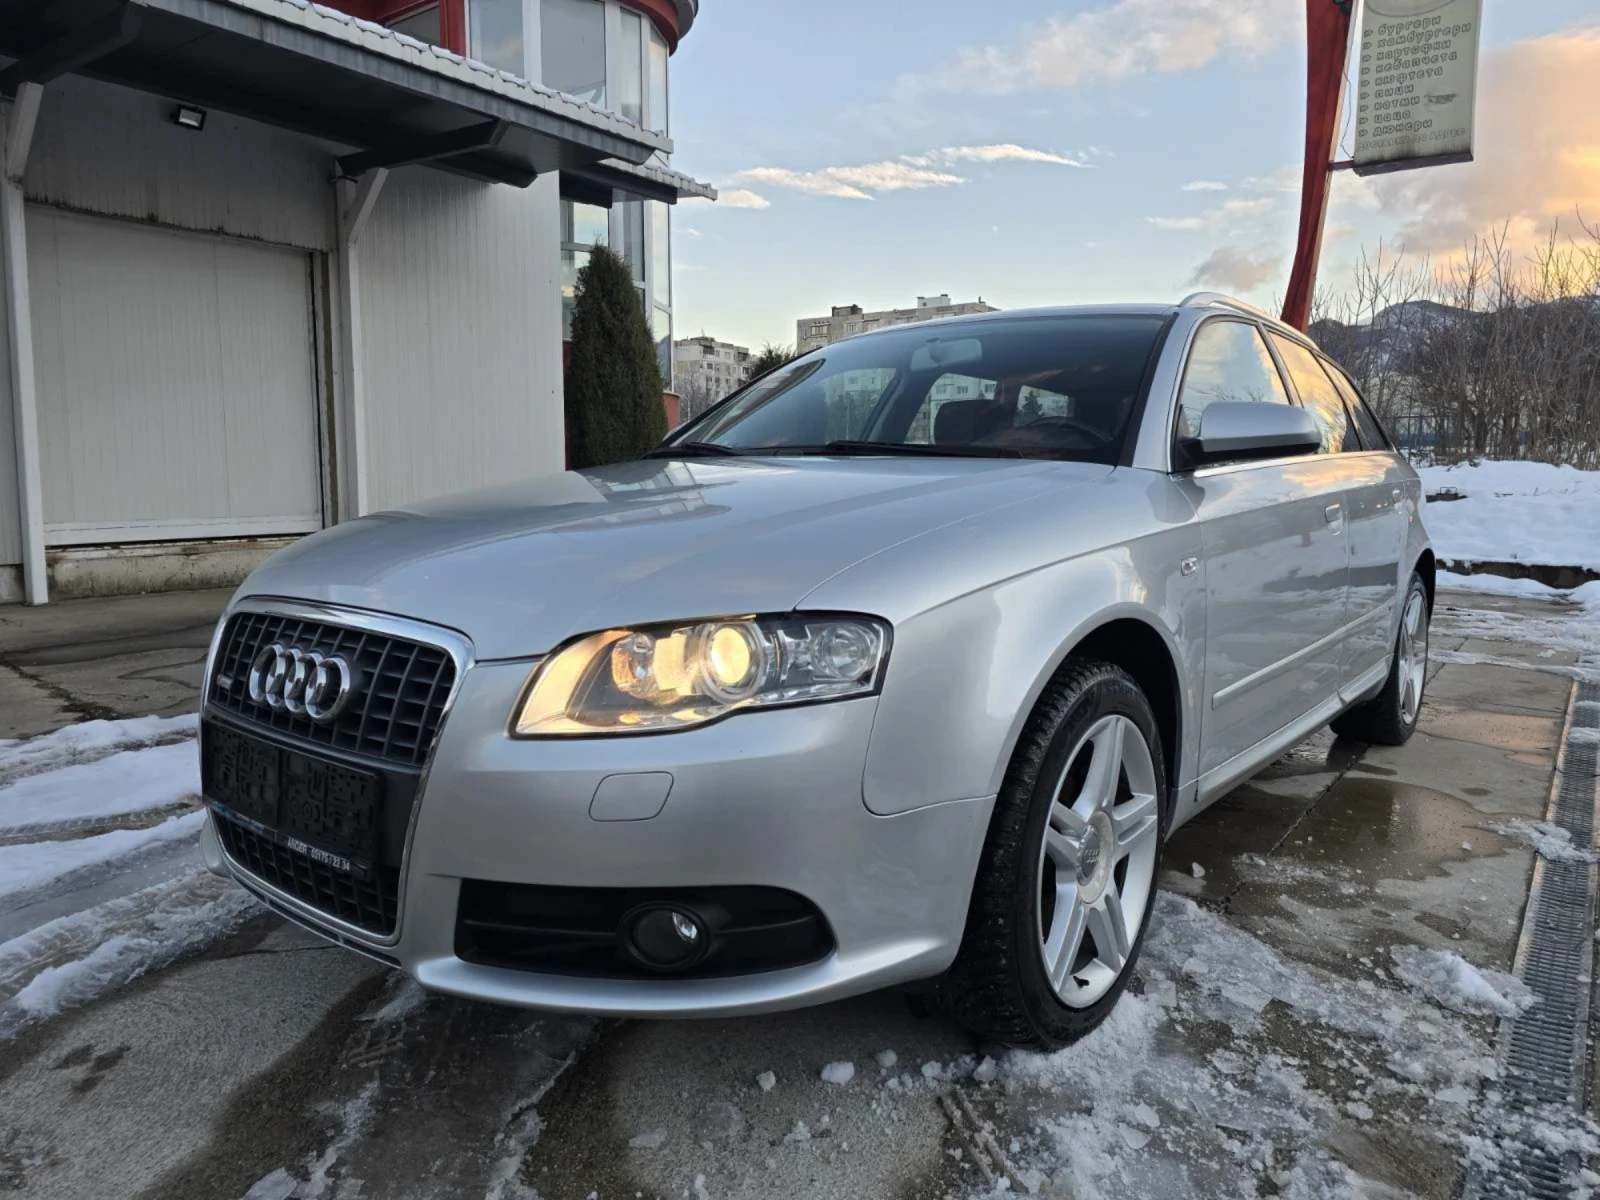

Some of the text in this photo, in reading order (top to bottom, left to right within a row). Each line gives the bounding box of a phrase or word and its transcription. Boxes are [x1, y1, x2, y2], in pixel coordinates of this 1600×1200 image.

[1377, 22, 1472, 48] хамбургери
[1378, 16, 1442, 36] бургери
[1375, 51, 1458, 74] кебапчета
[1374, 66, 1444, 87] кюфтета
[1372, 119, 1433, 137] дюнери
